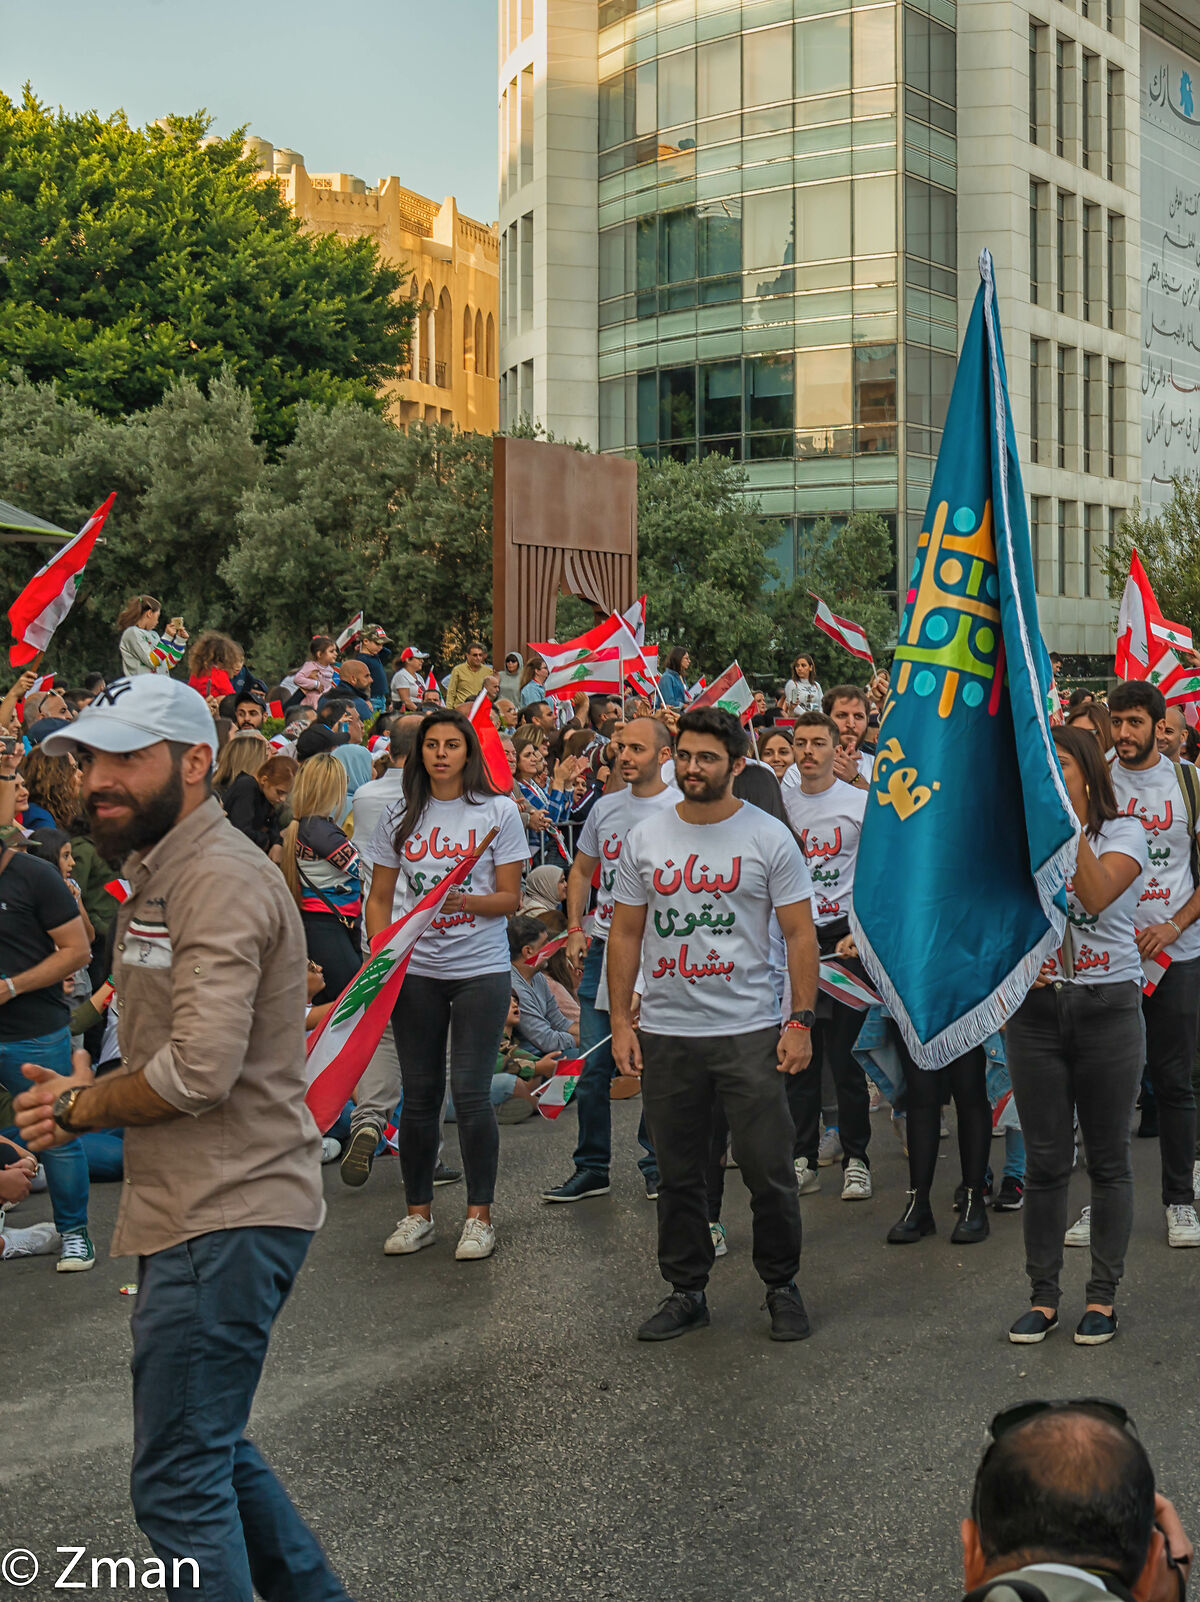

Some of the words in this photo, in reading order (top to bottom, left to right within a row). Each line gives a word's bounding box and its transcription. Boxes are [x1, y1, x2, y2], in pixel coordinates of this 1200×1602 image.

[1185, 408, 1193, 447] في
[404, 826, 477, 862] لبنان
[801, 826, 843, 861] لبنا
[652, 853, 743, 900] لبنان
[811, 864, 841, 887] بيق
[652, 943, 736, 985] بشبابو
